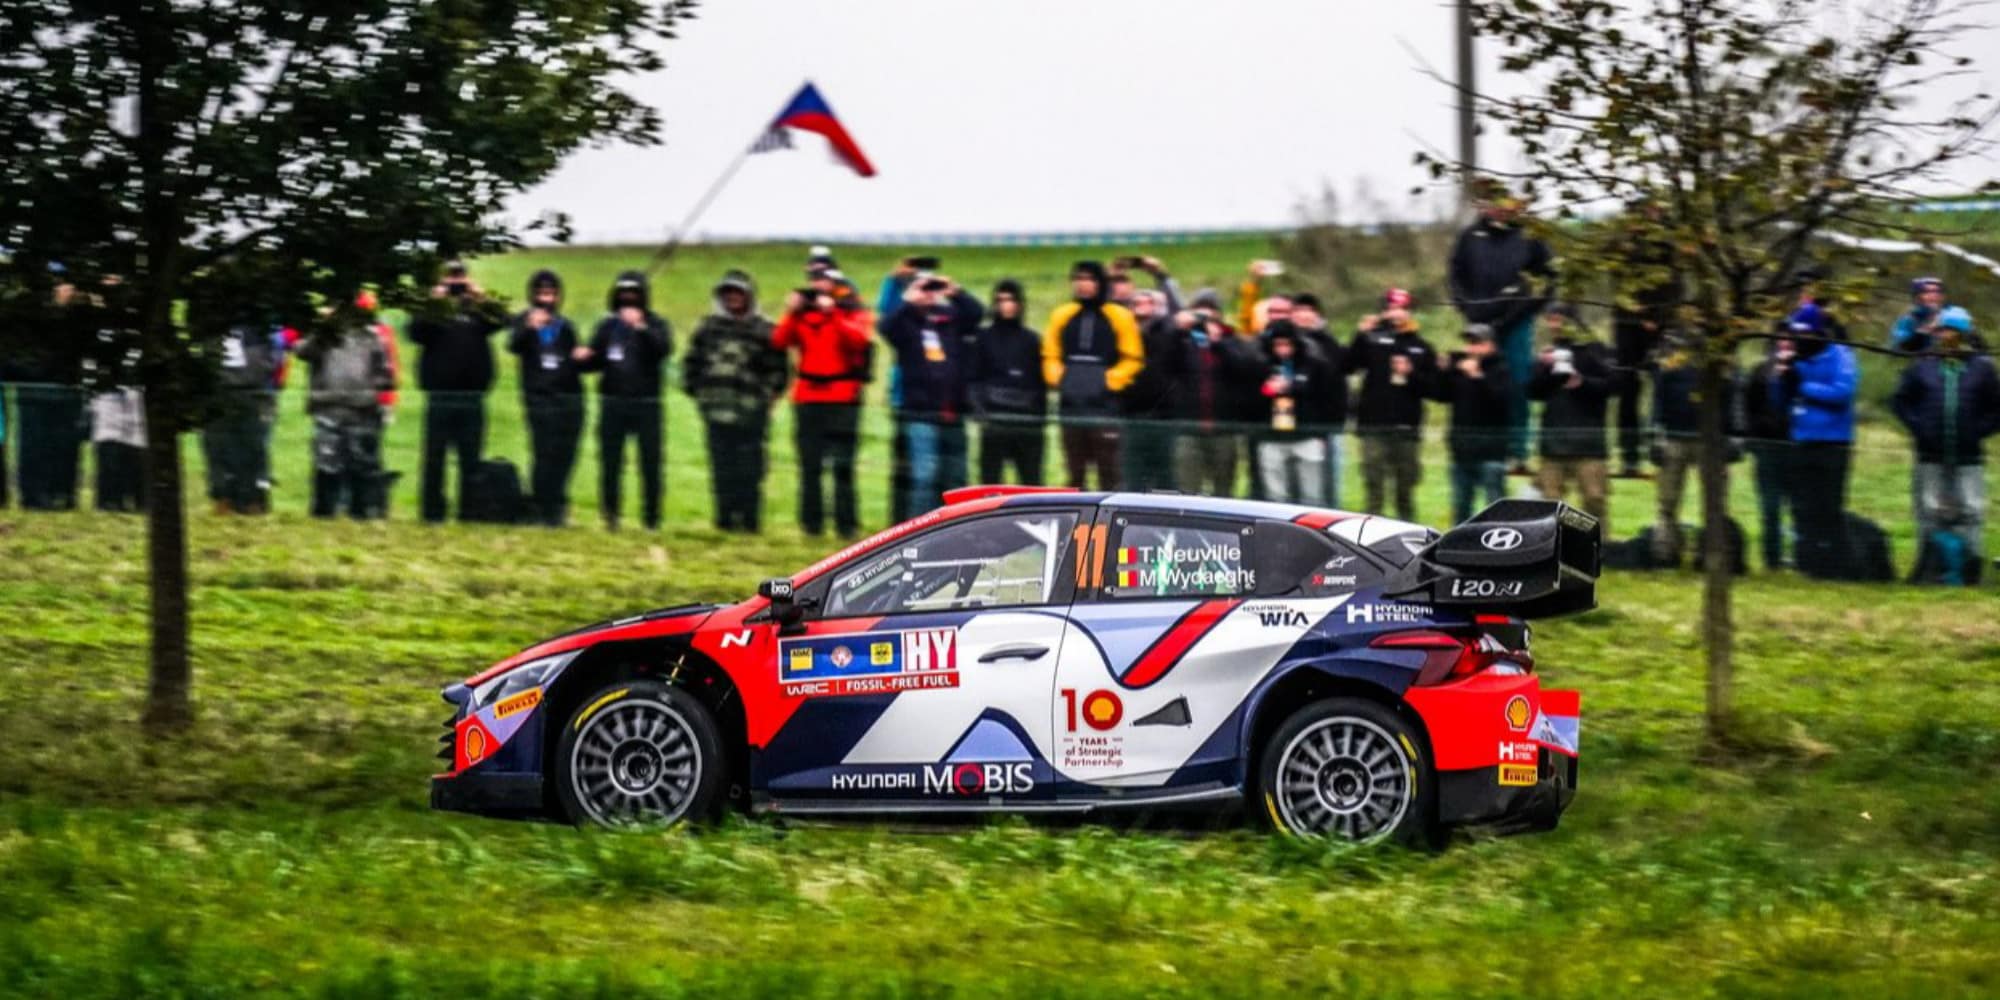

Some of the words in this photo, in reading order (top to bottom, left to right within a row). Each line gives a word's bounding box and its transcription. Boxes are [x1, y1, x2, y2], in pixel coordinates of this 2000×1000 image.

[1073, 523, 1108, 590] 11
[1375, 603, 1434, 615] HYUNDAI
[1259, 608, 1309, 627] WIA
[1375, 612, 1418, 622] STEEL
[905, 630, 955, 672] HY
[787, 683, 830, 696] WRC
[846, 675, 920, 692] FOSSIL-FREE
[922, 674, 952, 688] FUEL
[1061, 688, 1124, 733] 10
[1079, 738, 1108, 746] YEARS
[1065, 747, 1077, 757] of
[1079, 746, 1122, 758] Strategic
[1064, 758, 1124, 768] Partnership
[832, 773, 916, 790] HYUNDAI
[923, 762, 1034, 796] MOBIS
